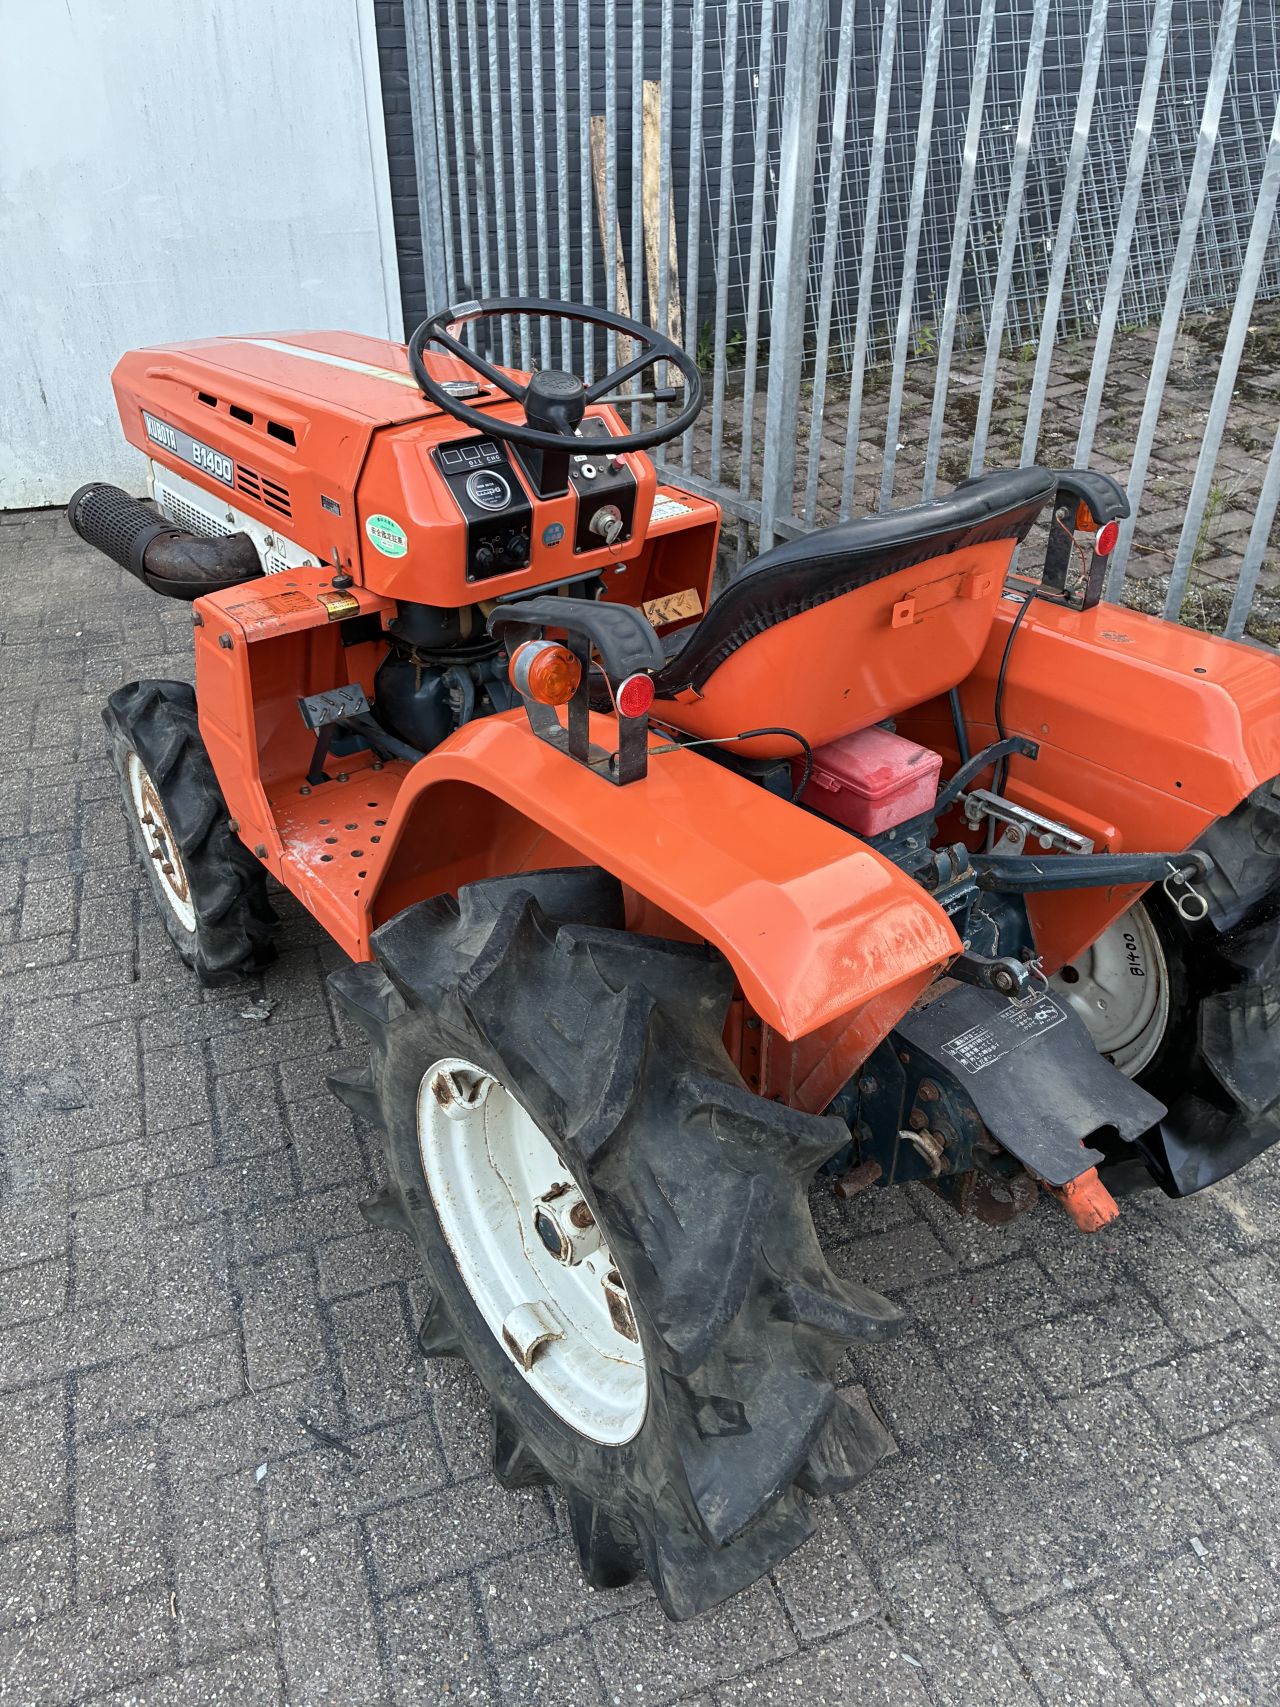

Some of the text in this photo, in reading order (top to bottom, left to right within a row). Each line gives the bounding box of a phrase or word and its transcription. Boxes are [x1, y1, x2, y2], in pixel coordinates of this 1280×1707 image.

[146, 416, 177, 452] KUBOTA
[192, 441, 233, 484] B1400
[486, 454, 500, 462] CHG
[1123, 933, 1145, 977] B1400
